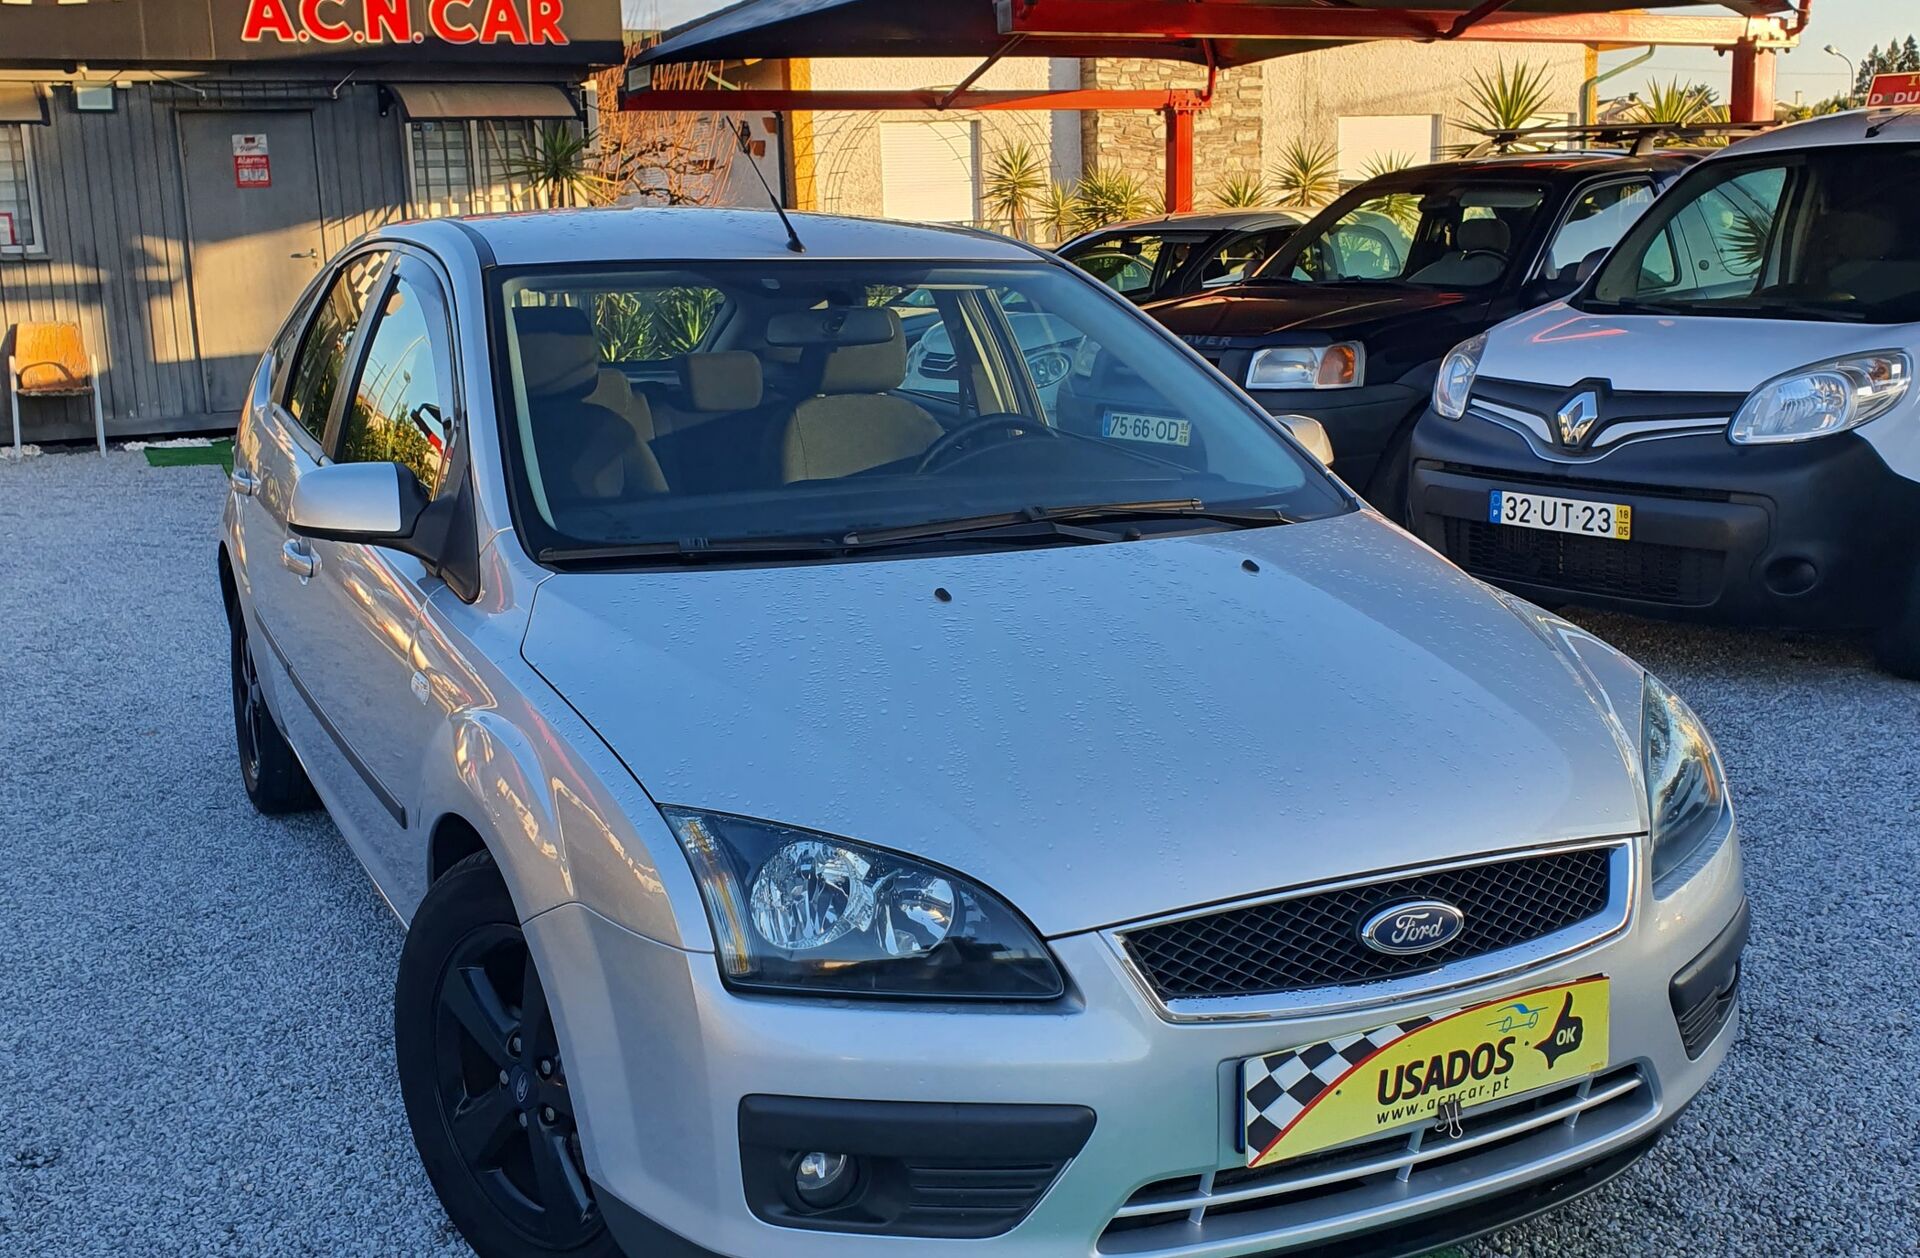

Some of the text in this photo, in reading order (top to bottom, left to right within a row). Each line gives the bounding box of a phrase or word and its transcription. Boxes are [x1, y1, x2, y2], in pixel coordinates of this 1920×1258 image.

[241, 0, 571, 45] A.C.N. CAR
[1493, 509, 1498, 517] P
[1619, 509, 1629, 519] 18
[1618, 527, 1629, 536] 05
[1391, 912, 1443, 943] Ford
[1556, 1027, 1576, 1046] OK
[1377, 1036, 1516, 1105] USADOS
